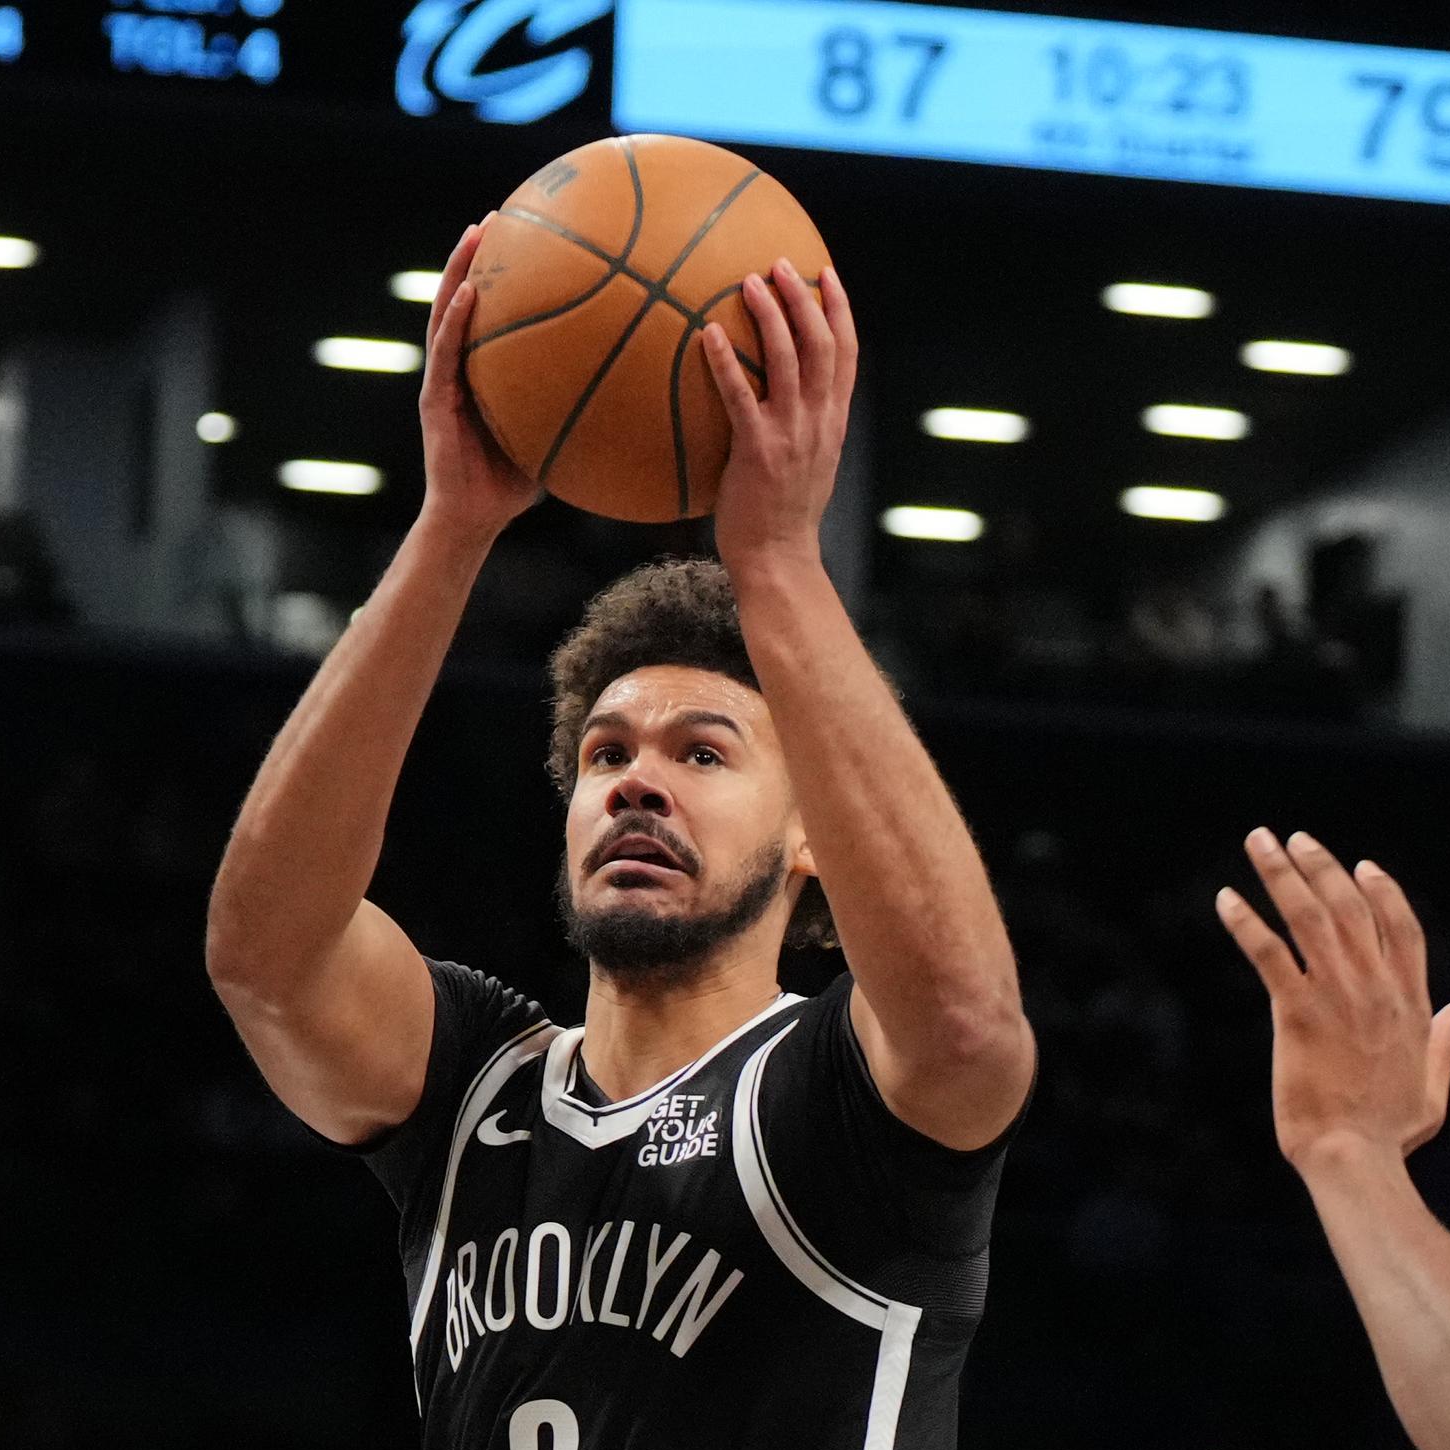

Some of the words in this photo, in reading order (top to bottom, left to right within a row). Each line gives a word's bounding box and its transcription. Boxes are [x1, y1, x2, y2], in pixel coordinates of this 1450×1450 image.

[814, 25, 951, 122] 87
[1046, 42, 1248, 116] 10:23
[647, 1111, 717, 1142] YOUR
[651, 1095, 705, 1119] GET
[638, 1133, 718, 1167] GUIDE
[444, 1220, 745, 1374] BROOKLYN
